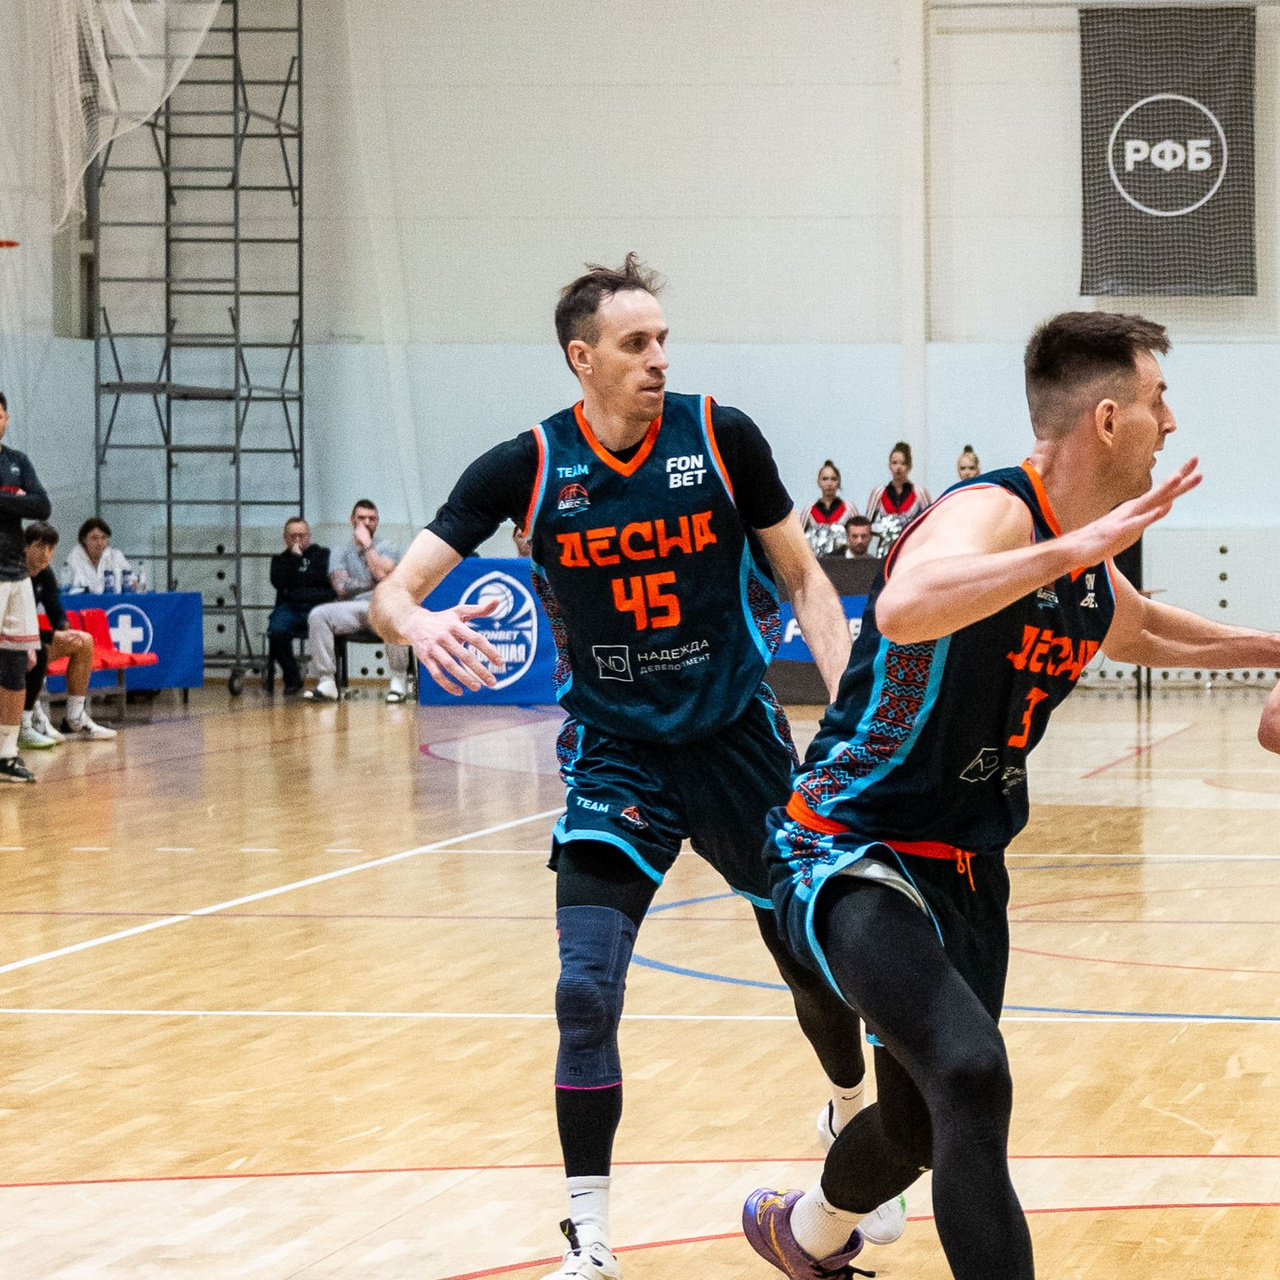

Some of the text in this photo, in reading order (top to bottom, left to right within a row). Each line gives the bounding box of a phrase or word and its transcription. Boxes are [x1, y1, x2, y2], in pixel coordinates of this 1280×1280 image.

[1124, 138, 1213, 171] РФБ
[556, 463, 590, 478] TEAM
[666, 454, 704, 473] FON
[669, 470, 707, 489] BET
[555, 510, 718, 568] ДЕСНА
[611, 571, 682, 631] 45
[637, 639, 710, 662] НАДЕЖДА
[577, 796, 609, 813] TEAM
